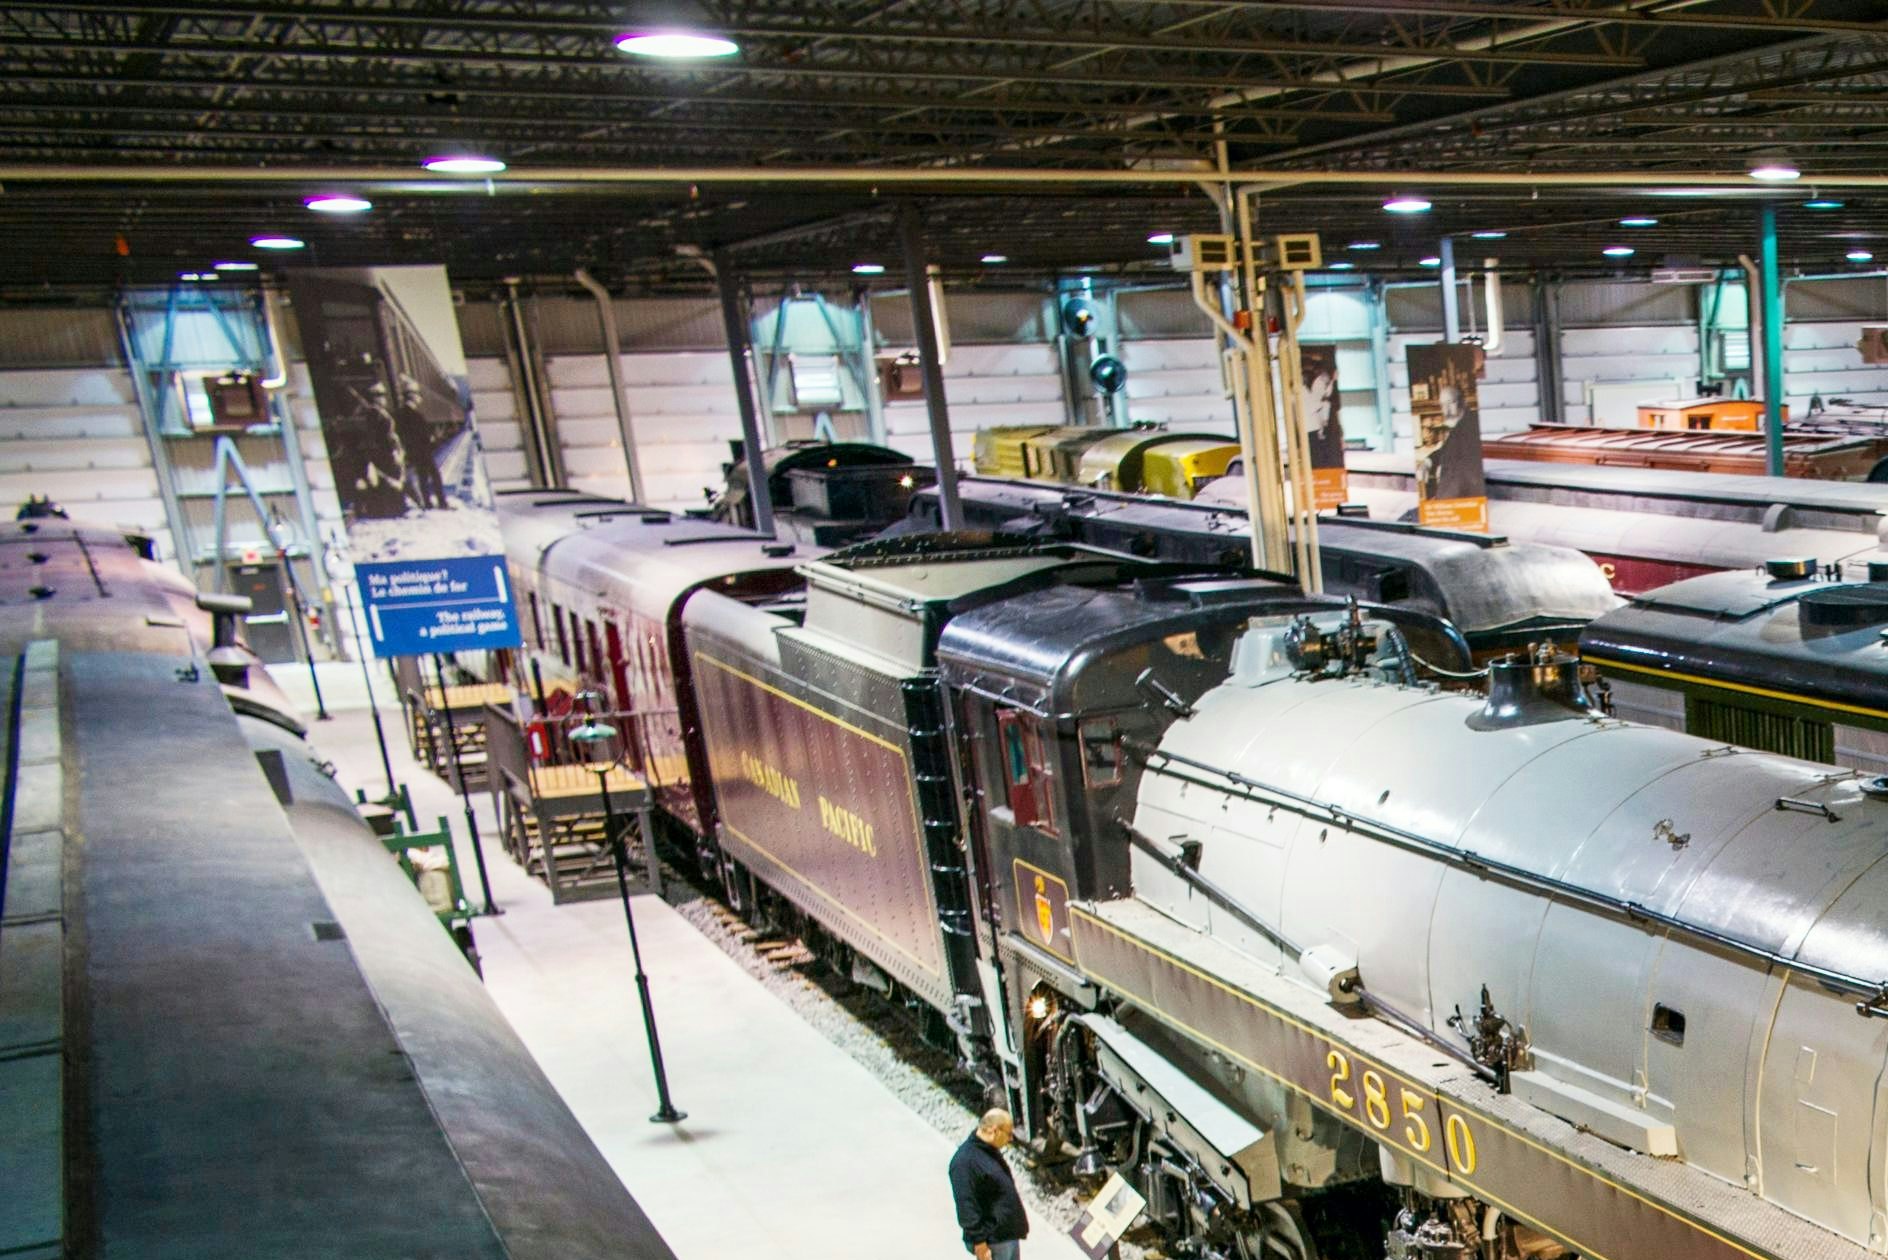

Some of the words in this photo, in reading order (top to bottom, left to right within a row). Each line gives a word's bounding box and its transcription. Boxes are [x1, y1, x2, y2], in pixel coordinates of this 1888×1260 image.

[371, 586, 387, 598] Le
[388, 584, 432, 597] chemin
[433, 582, 448, 594] de
[450, 580, 469, 593] fer
[436, 610, 459, 623] The
[419, 626, 428, 637] a
[429, 621, 476, 639] political
[477, 620, 509, 635] game
[817, 795, 877, 858] PACIFIC
[1326, 1049, 1477, 1175] 2850
